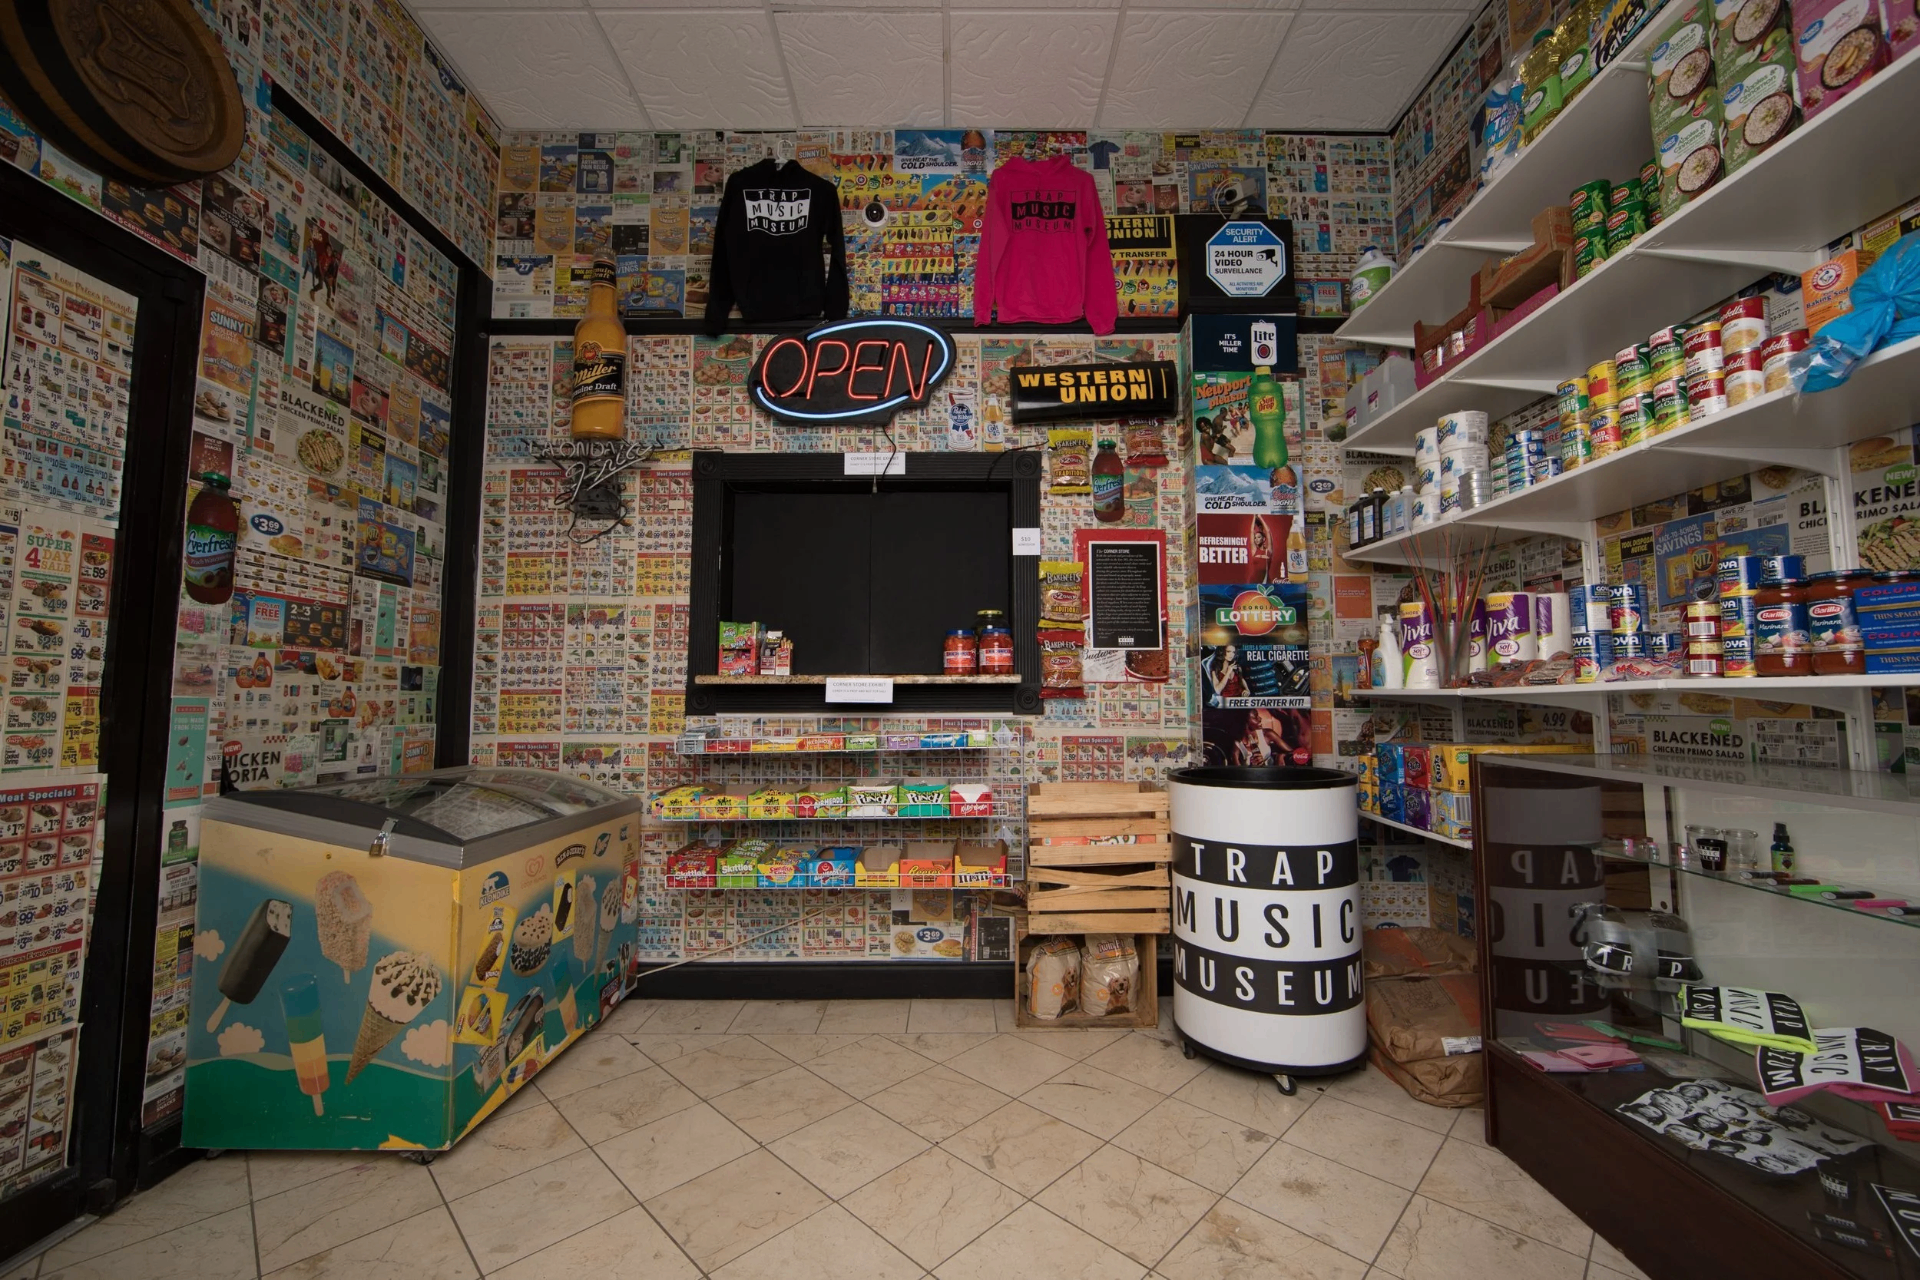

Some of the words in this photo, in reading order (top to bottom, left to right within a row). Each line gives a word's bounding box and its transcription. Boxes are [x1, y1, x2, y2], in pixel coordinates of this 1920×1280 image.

[901, 161, 926, 170] COLD
[758, 190, 798, 201] TRAP
[1024, 191, 1064, 201] TRAP
[752, 202, 803, 218] MUSIC
[1017, 205, 1070, 218] MUSIC
[750, 217, 806, 233] MUSEUM
[1014, 219, 1071, 230] MUSEUM
[1105, 218, 1155, 229] STERN
[1226, 229, 1263, 237] SECURITY
[1232, 235, 1257, 243] ALERT
[1227, 250, 1253, 258] HOUR
[1215, 259, 1243, 267] VIDEO
[1806, 295, 1832, 309] Baking
[1254, 331, 1275, 343] Lite
[574, 364, 617, 386] Miller
[761, 338, 935, 400] OPEN
[1018, 369, 1147, 388] WESTERN
[1195, 375, 1252, 399] Newport
[1060, 384, 1148, 404] UNION
[281, 390, 345, 427] BLACKENED
[280, 403, 305, 421] CHICKEN
[306, 413, 325, 428] PRIMO
[326, 421, 345, 436] SALAD
[1886, 470, 1916, 481] NEW!
[1094, 479, 1123, 494] Everfresh
[1857, 507, 1887, 519] RIMO
[1659, 523, 1699, 543] BACK-TO-SCHOOL
[27, 534, 72, 552] SUPER
[186, 530, 235, 555] Everfresh
[1199, 536, 1248, 546] REFRESHINGLY
[1655, 530, 1702, 555] SAVINGS
[1631, 544, 1648, 553] NOTICE
[25, 547, 40, 569] 4
[42, 548, 72, 563] DAY
[1199, 547, 1248, 564] BETTER
[1693, 551, 1713, 567] RITZ
[41, 561, 71, 573] SALE
[1469, 560, 1516, 579] BLCKENED
[1718, 561, 1738, 569] OYA
[1047, 573, 1081, 583] BAKEN-ETS
[1609, 587, 1632, 597] OYA
[1861, 586, 1917, 597] COLUM
[255, 608, 280, 618] FREE
[1220, 610, 1293, 622] LOTTERY
[1763, 611, 1790, 620] Barilla
[1813, 605, 1842, 615] Barilla
[1812, 619, 1842, 627] Marinara
[1044, 641, 1075, 649] BAKEN-ETS
[1572, 637, 1592, 646] OYA
[1613, 636, 1640, 645] OYA
[1247, 651, 1265, 661] REAL
[1268, 650, 1309, 661] CIGARETTE
[1229, 699, 1248, 707] FREE
[1251, 699, 1287, 707] STARTER
[1467, 719, 1515, 730] BLACKENED
[1542, 713, 1566, 727] 4.99
[1710, 722, 1731, 732] NEW!
[1653, 730, 1743, 748] BLACKENED
[224, 744, 241, 752] NEW!
[1653, 745, 1686, 754] CHICKEN
[1687, 746, 1713, 756] PRIMO
[1715, 750, 1745, 759] SALAD
[230, 769, 269, 784] ORTA
[28, 788, 76, 799] Specials!
[855, 793, 892, 804] PUNCH
[906, 792, 944, 804] PUNCH
[722, 865, 753, 874] Skittles
[1191, 842, 1334, 885] TRAP
[479, 886, 510, 905] KLONDIKE
[1176, 886, 1355, 948] MUSIC
[27, 945, 61, 959] Everyday
[1175, 949, 1362, 1006] MUSEUM
